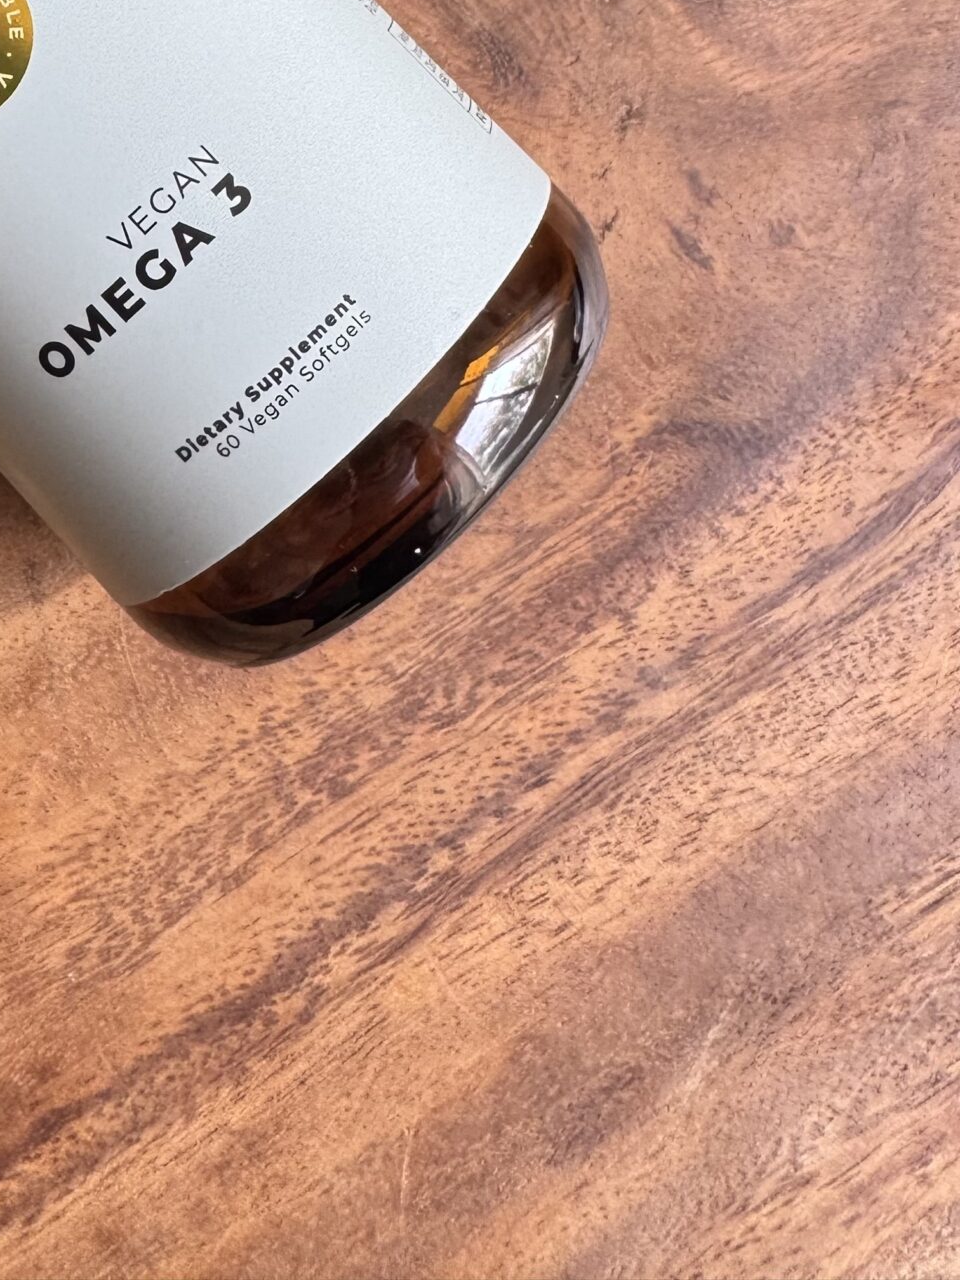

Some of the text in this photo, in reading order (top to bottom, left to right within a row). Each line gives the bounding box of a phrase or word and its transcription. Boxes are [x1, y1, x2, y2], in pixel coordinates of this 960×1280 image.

[38, 172, 252, 378] OMEGA 3
[105, 144, 220, 250] VEGAN
[175, 293, 358, 463] Dietary Supplement
[215, 308, 372, 459] 60 Vegan Softgels
